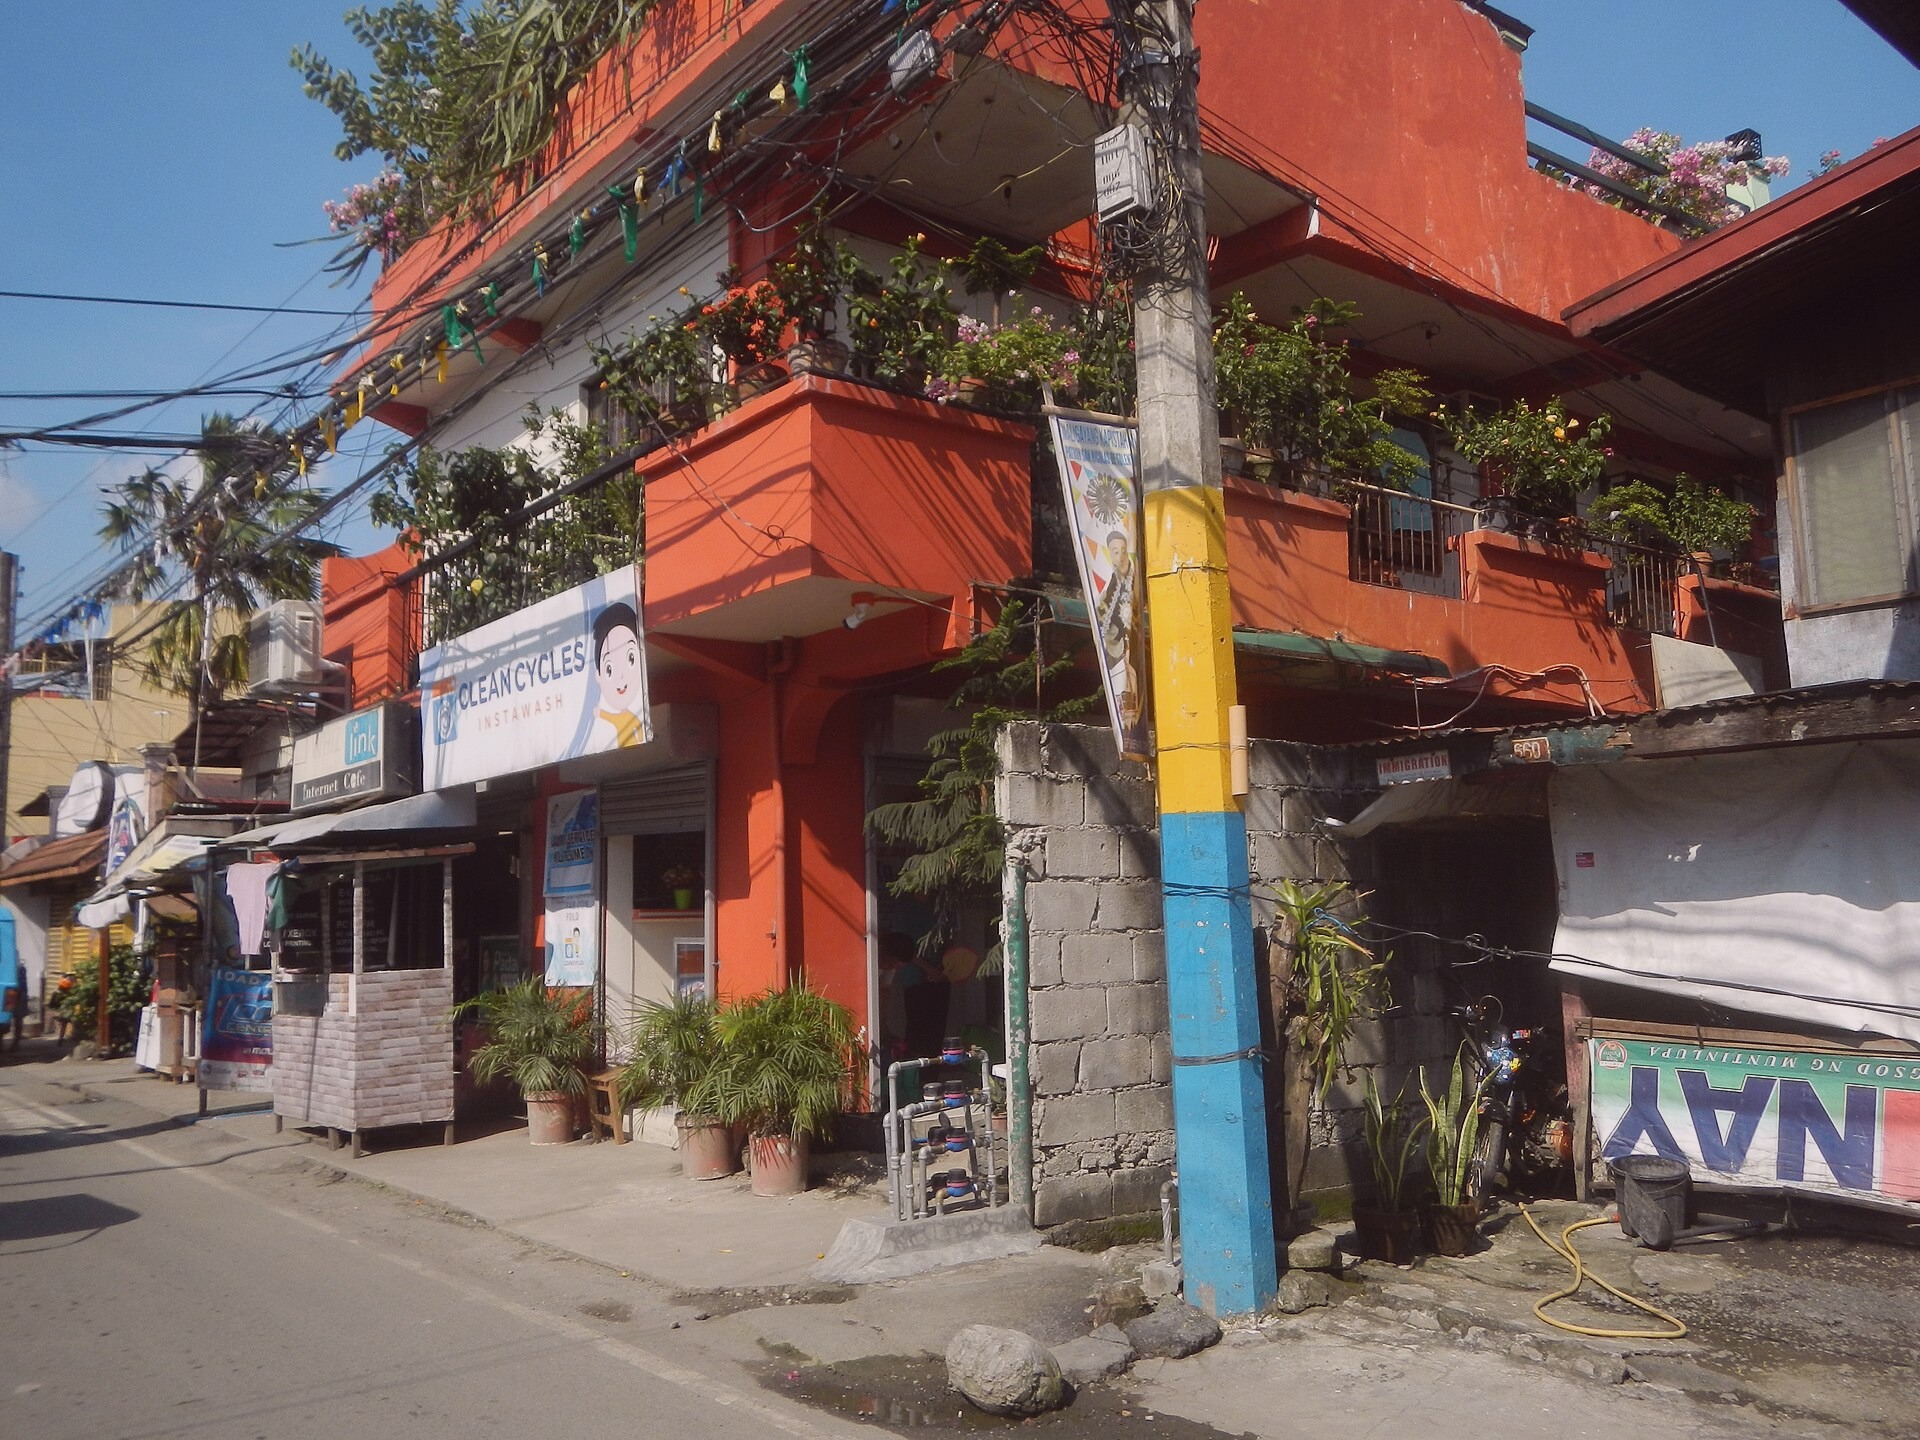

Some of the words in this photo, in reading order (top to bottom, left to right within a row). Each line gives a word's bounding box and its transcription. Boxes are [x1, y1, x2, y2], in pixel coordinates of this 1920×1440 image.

[459, 668, 512, 711] CLEAN
[515, 641, 586, 693] CYCLES
[478, 693, 564, 732] INSTAWASH
[1378, 754, 1448, 775] IMMIGRATION
[302, 780, 338, 801] Internet
[217, 969, 260, 986] LOAD
[1649, 1045, 1798, 1069] MUNTINLUPA
[1809, 1058, 1843, 1073] NG
